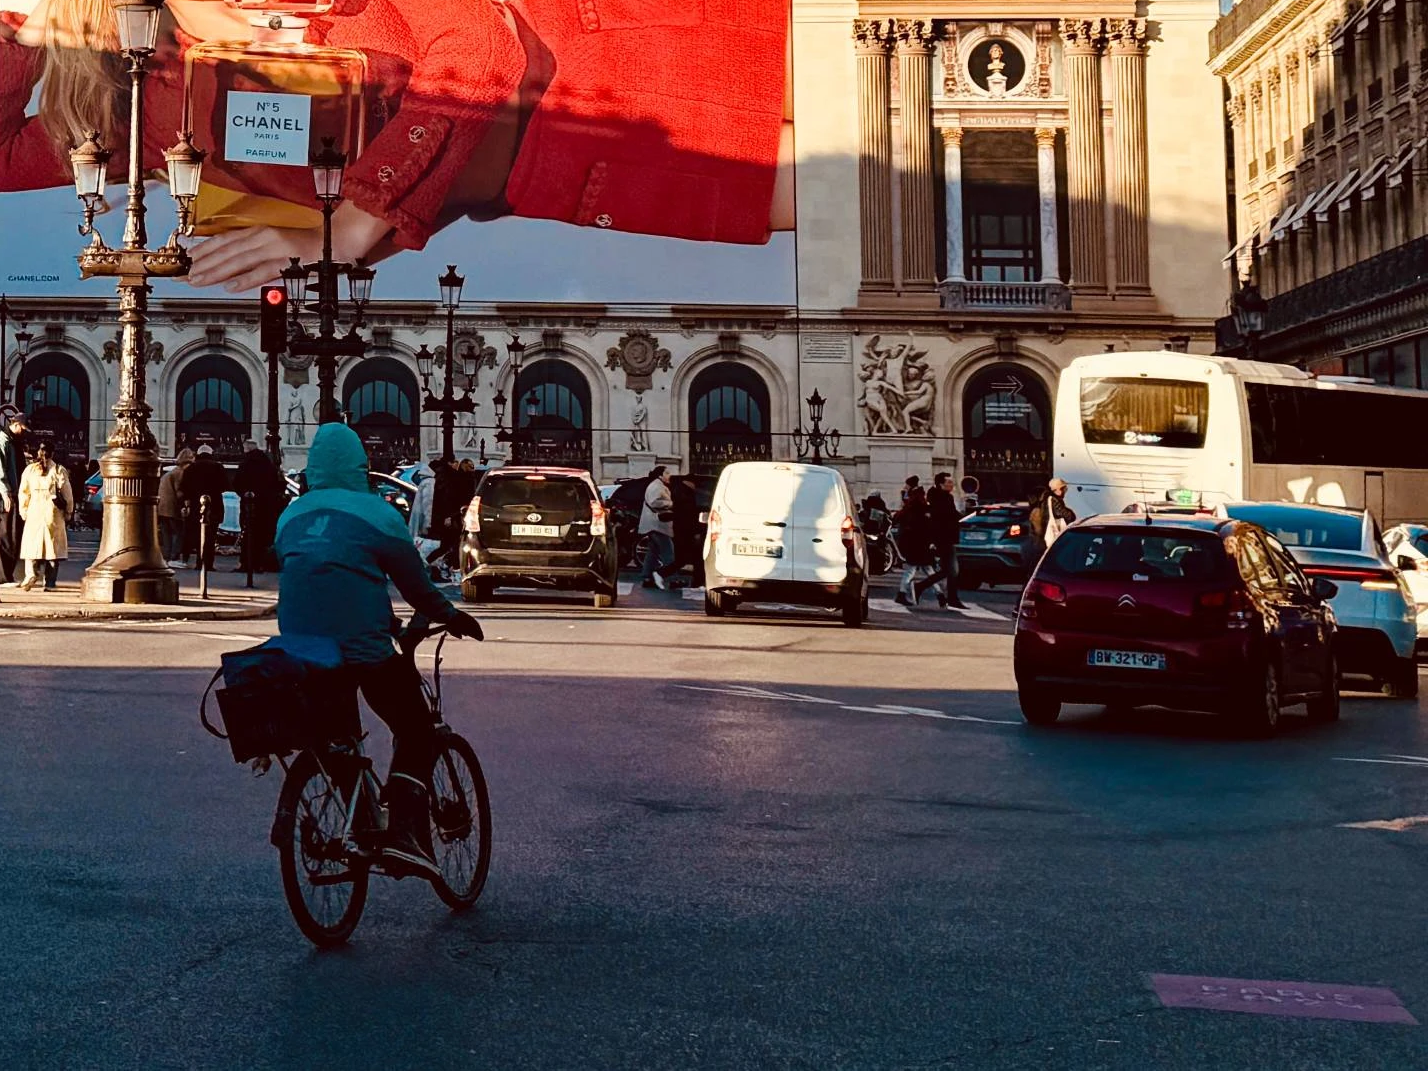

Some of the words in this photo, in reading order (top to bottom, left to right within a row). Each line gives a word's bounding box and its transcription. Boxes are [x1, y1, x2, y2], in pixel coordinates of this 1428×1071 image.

[272, 102, 280, 112] 5
[232, 115, 303, 131] CHANEL
[254, 132, 280, 140] PARIS
[245, 148, 287, 159] PARFUM
[7, 274, 60, 282] CHANEL.COM
